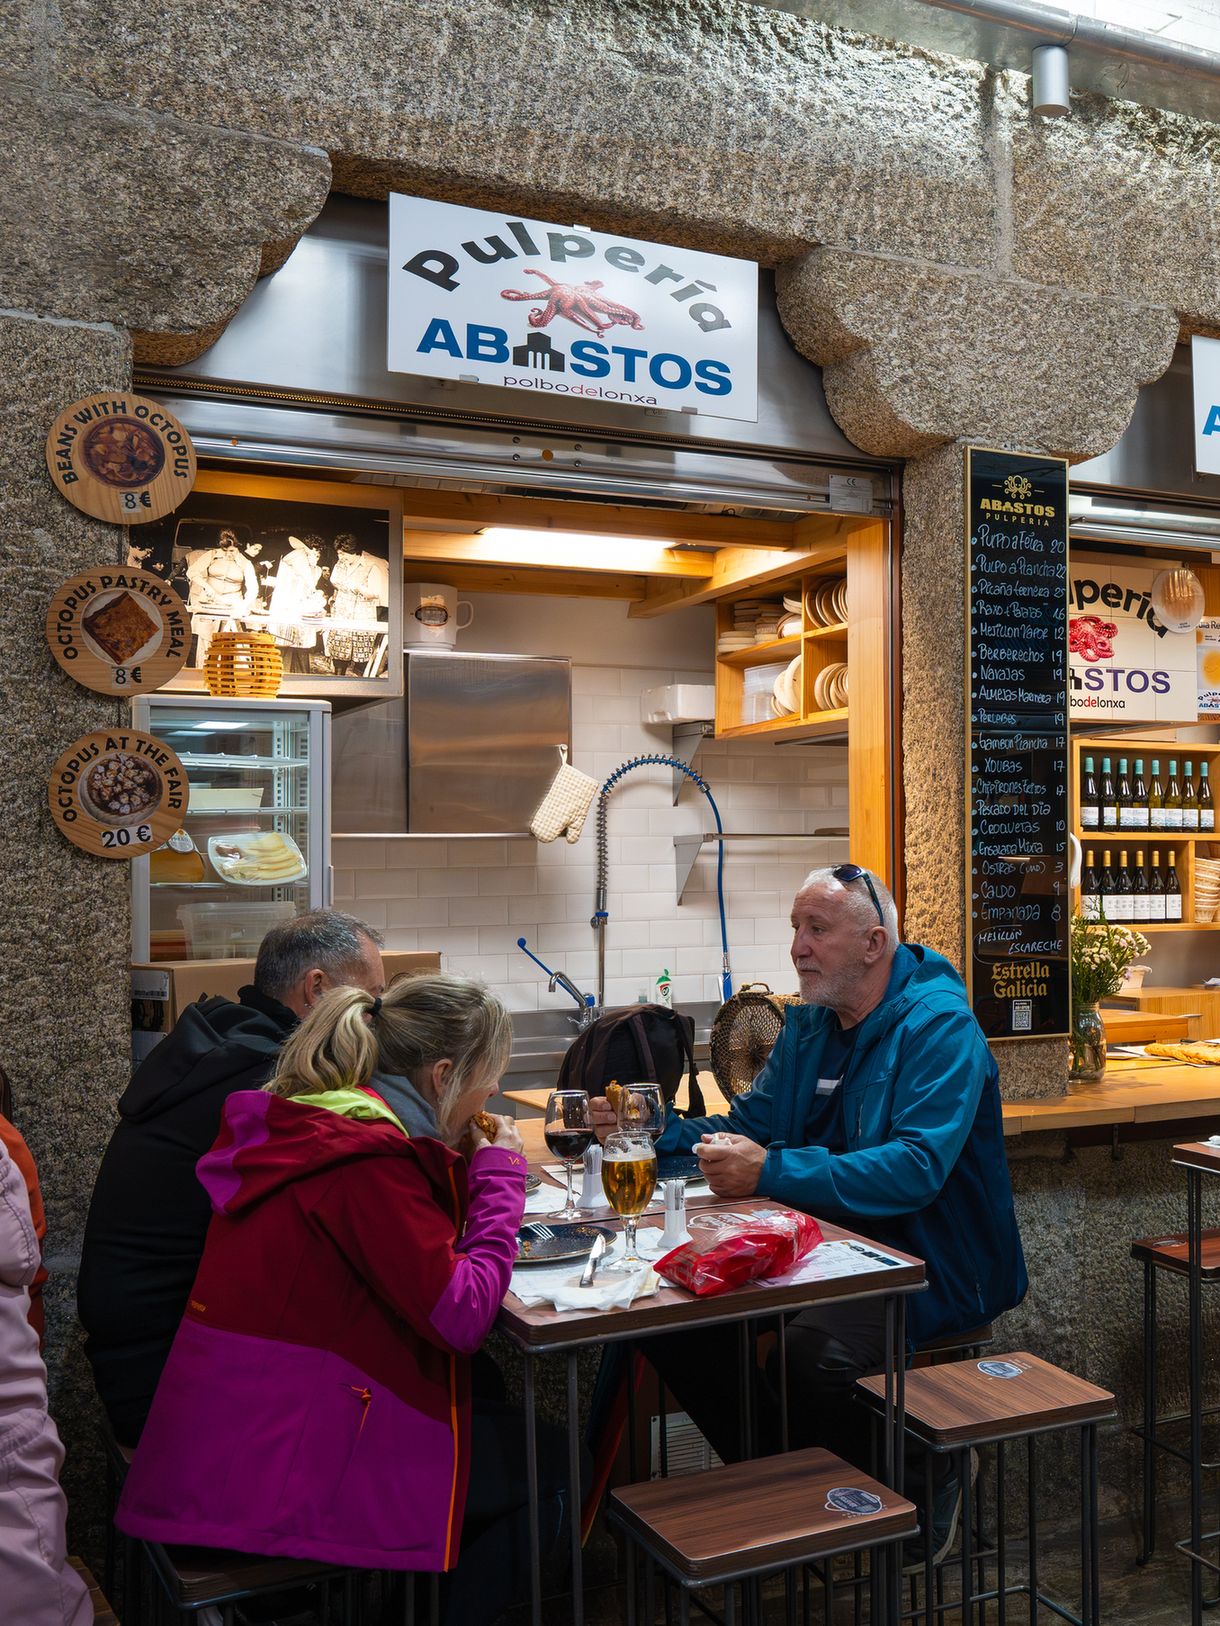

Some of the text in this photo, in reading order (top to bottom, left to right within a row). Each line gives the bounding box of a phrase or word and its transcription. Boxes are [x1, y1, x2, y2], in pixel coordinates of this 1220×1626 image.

[401, 221, 732, 332] Pulpería
[503, 374, 657, 405] polbodelonxa
[56, 401, 189, 485] BEANS WITH OCTOPUS
[985, 512, 1049, 527] PULPERIA
[1050, 539, 1065, 553] 20
[1056, 563, 1066, 579] 22
[1054, 587, 1066, 598] 25
[57, 574, 185, 660] OCTOPUS PASTRY MEAL
[1052, 607, 1066, 620] 16
[1052, 650, 1063, 663] 19
[1056, 691, 1065, 706] 19
[1070, 695, 1126, 709] bodelonxa
[1054, 713, 1064, 726] 19
[1055, 736, 1066, 748] 17
[1053, 760, 1066, 773] 17
[58, 736, 183, 822] OCTOPUS AT THE FAIR
[1056, 820, 1066, 831] 10
[1056, 842, 1066, 852] 15
[1055, 862, 1064, 873] 3
[1053, 881, 1060, 896] 9
[1051, 904, 1061, 921] 8
[991, 962, 1050, 980] Estrella
[993, 979, 1048, 998] Galicia
